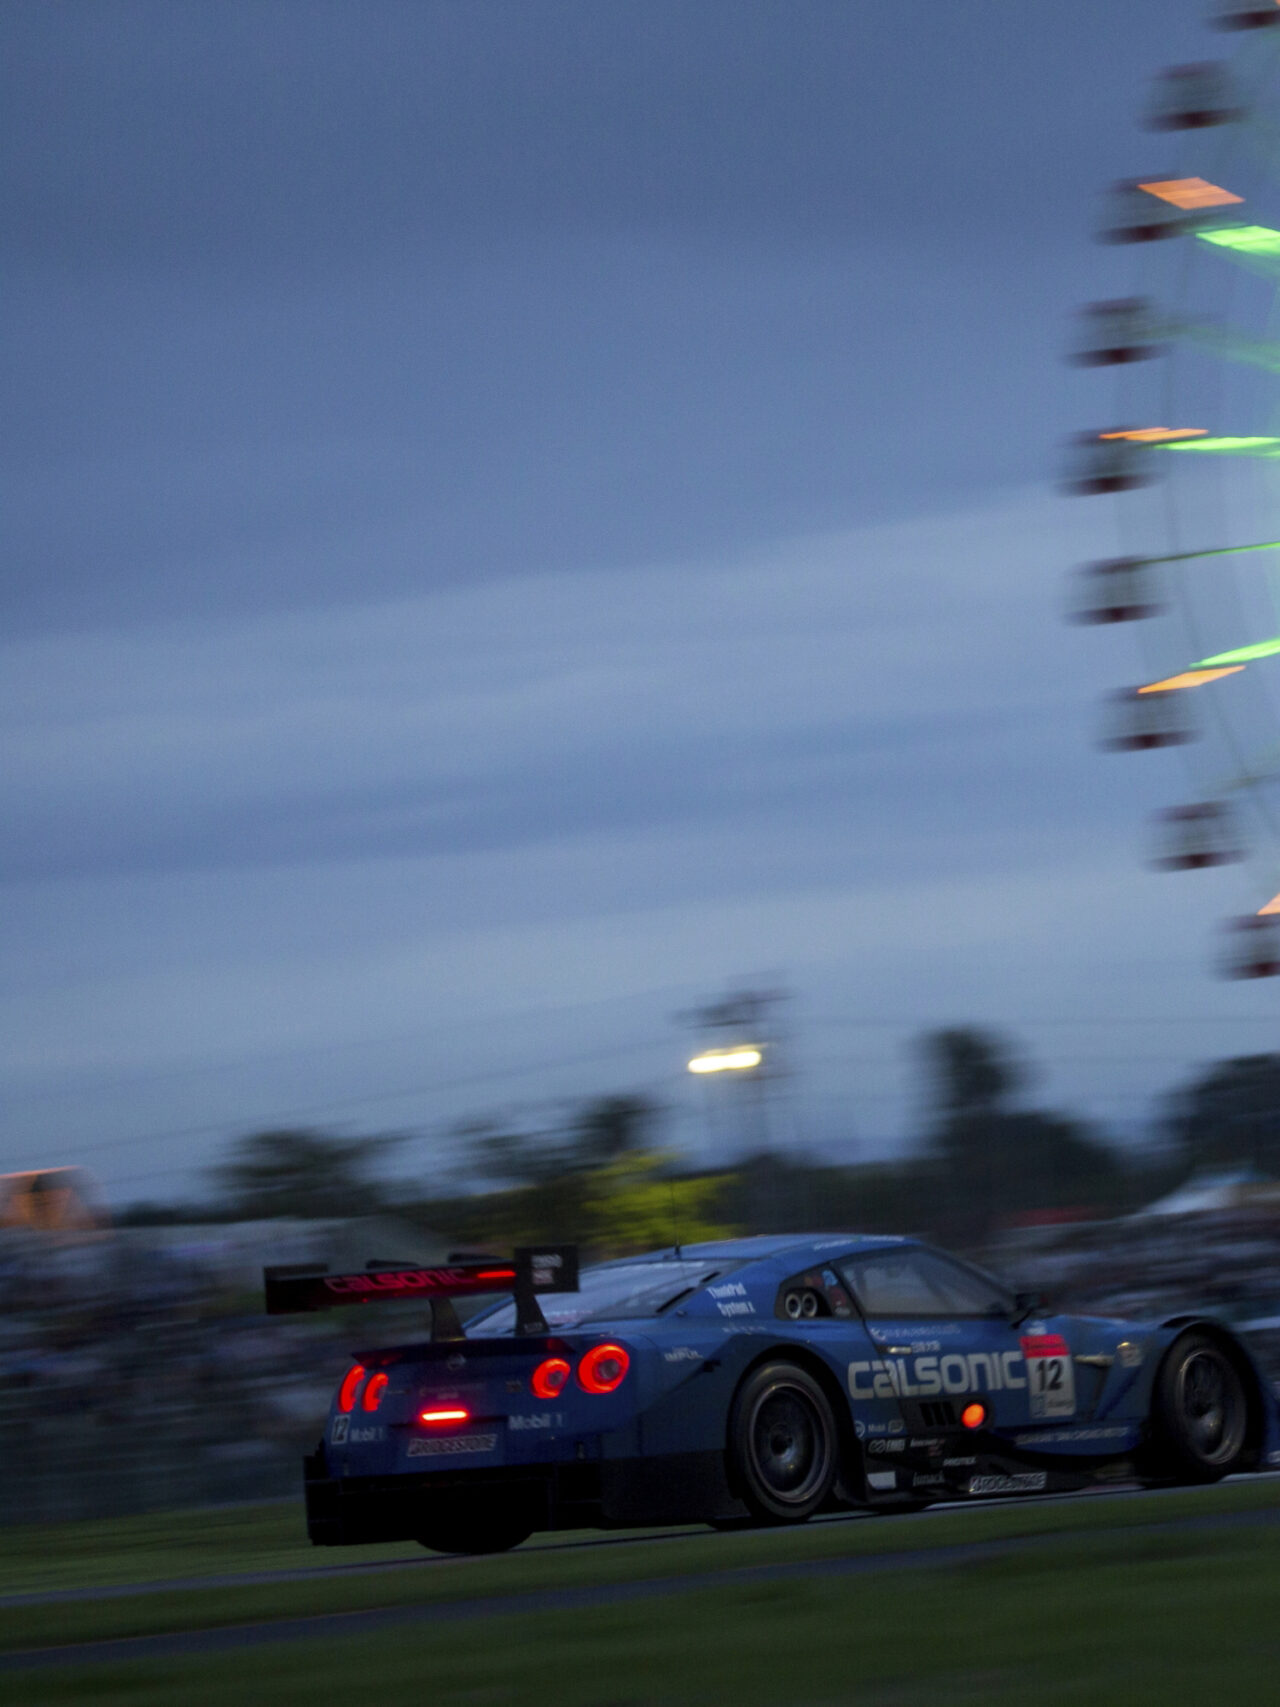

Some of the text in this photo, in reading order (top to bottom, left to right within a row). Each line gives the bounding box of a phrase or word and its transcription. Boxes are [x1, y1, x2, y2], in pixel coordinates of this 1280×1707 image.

[1036, 1359, 1063, 1391] 12
[332, 1416, 349, 1443] 12
[509, 1413, 550, 1431] Mobil
